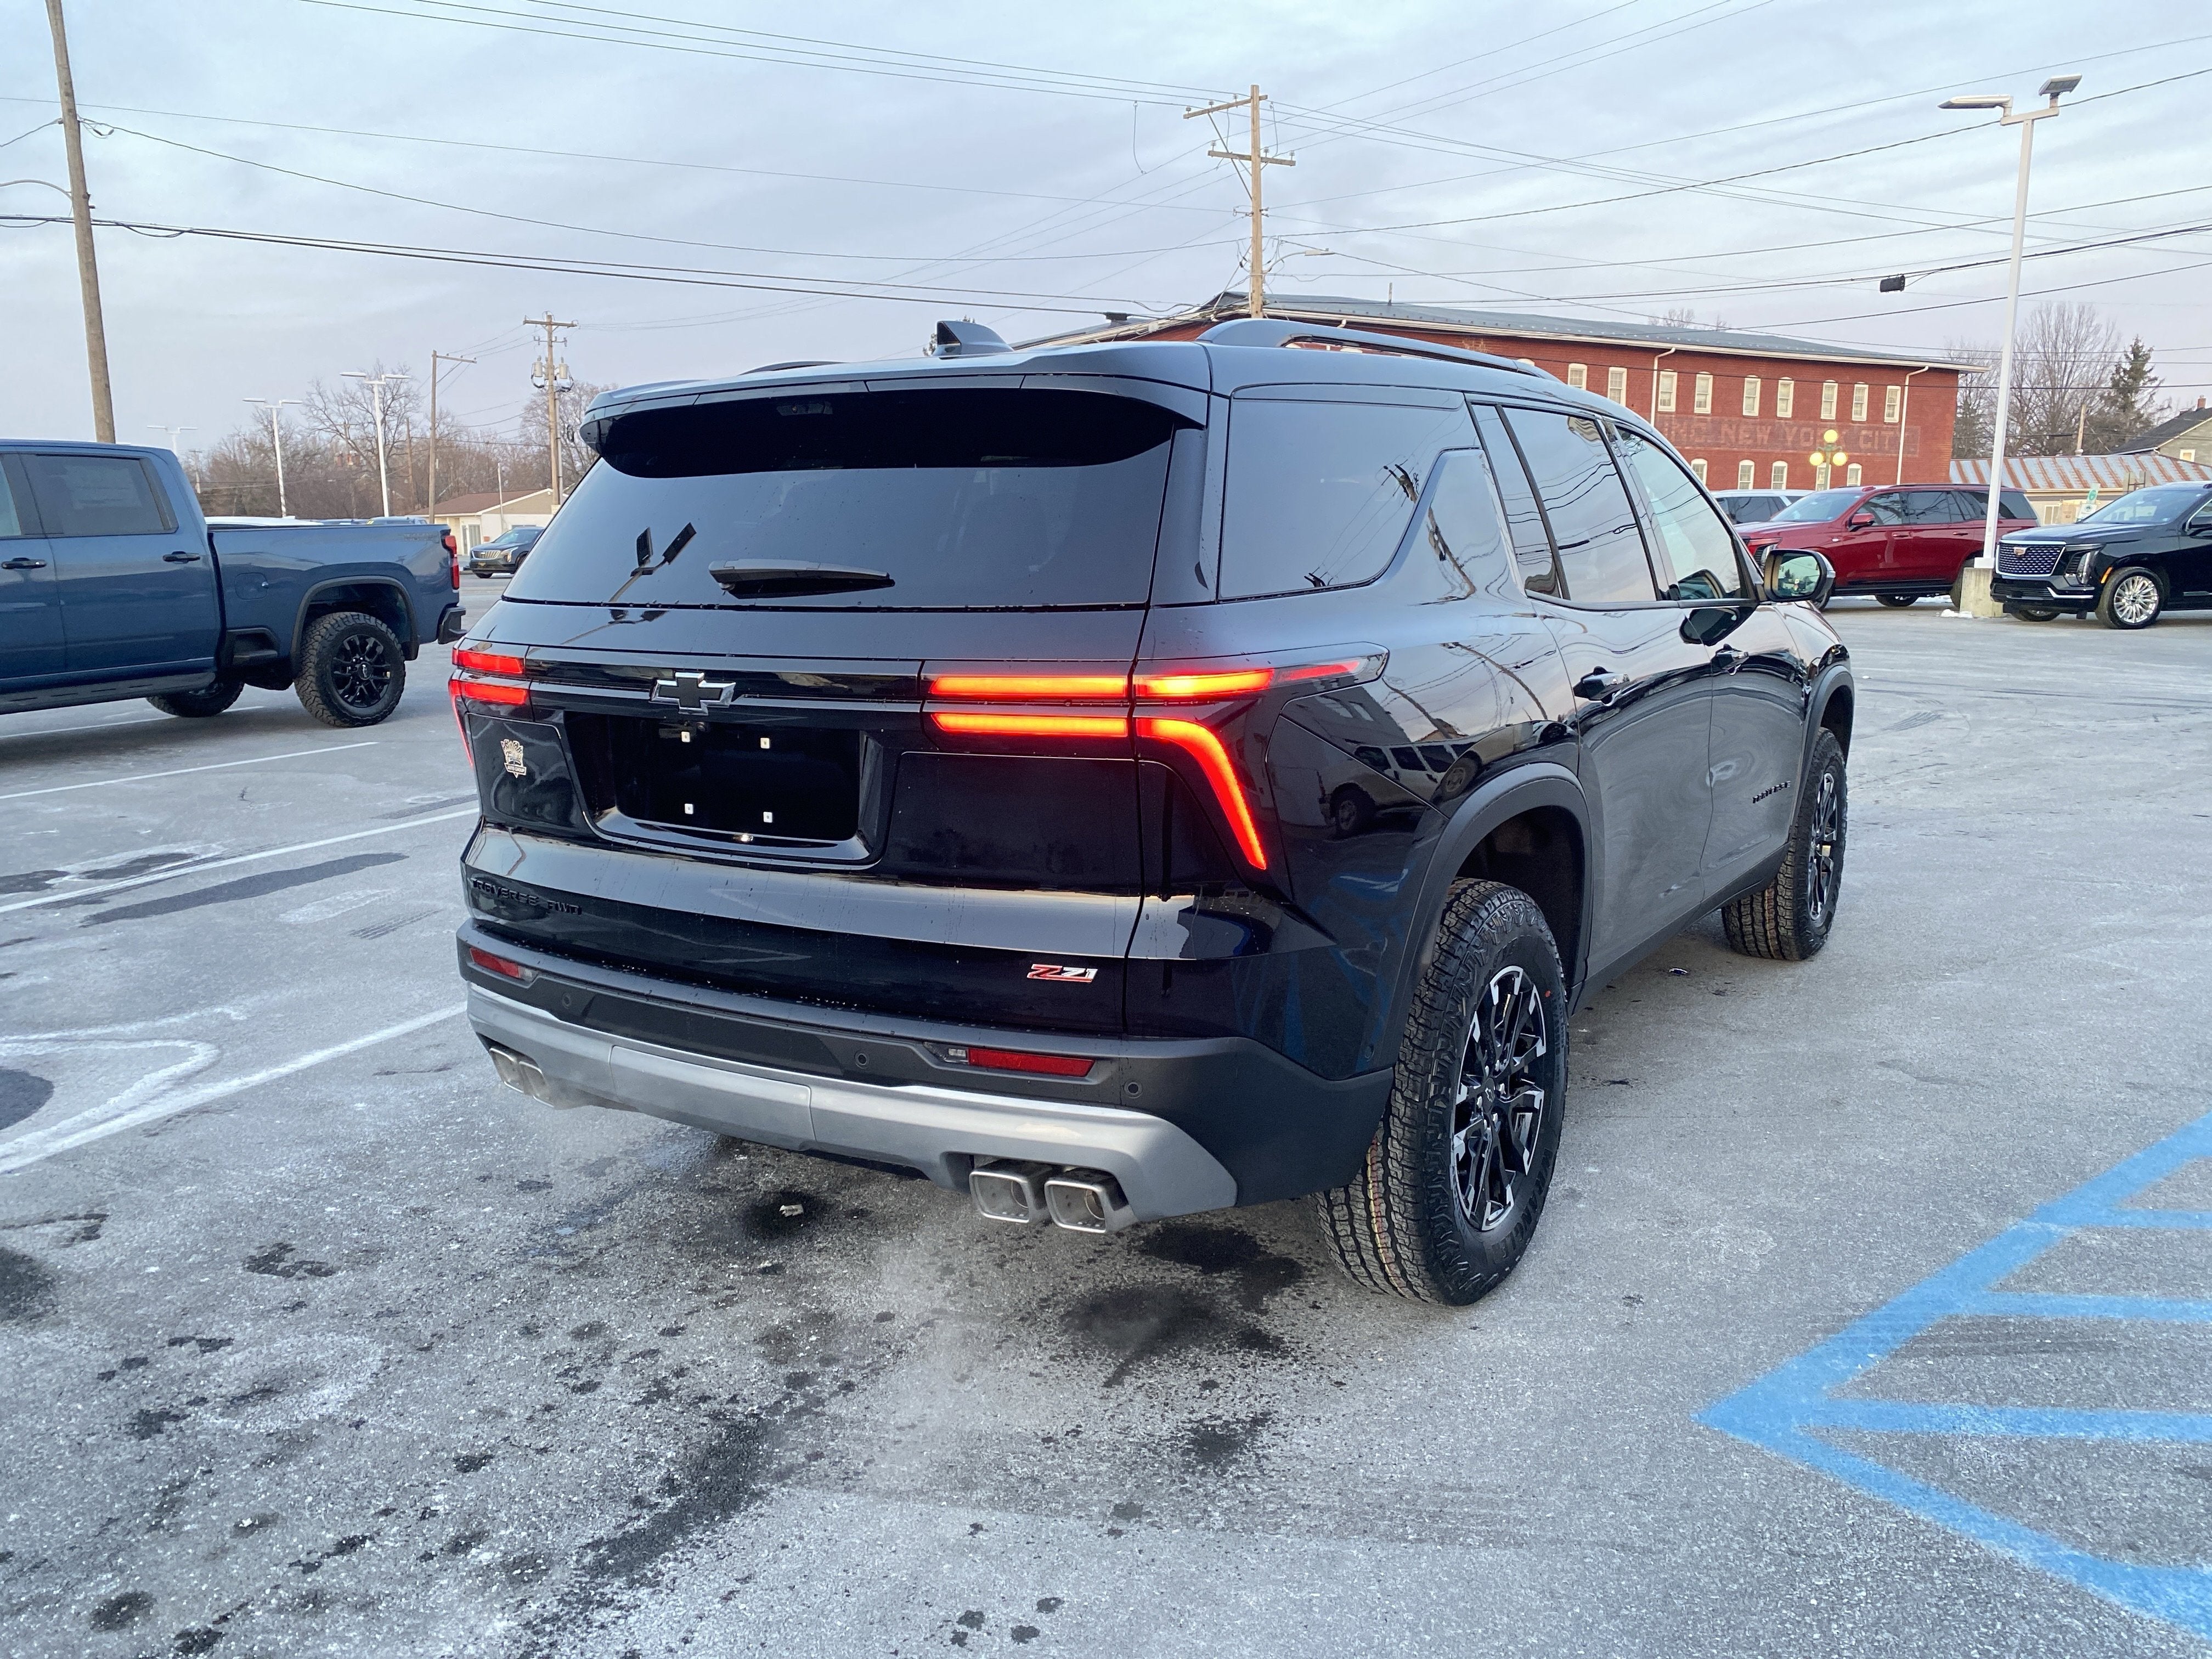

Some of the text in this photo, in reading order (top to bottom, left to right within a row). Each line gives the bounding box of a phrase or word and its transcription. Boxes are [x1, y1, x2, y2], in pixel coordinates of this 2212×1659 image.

[1720, 423, 1771, 445] NEW
[470, 878, 540, 906] TRAVERSE
[1027, 964, 1098, 984] Z71
[1491, 1148, 1554, 1264] WRANGLER
